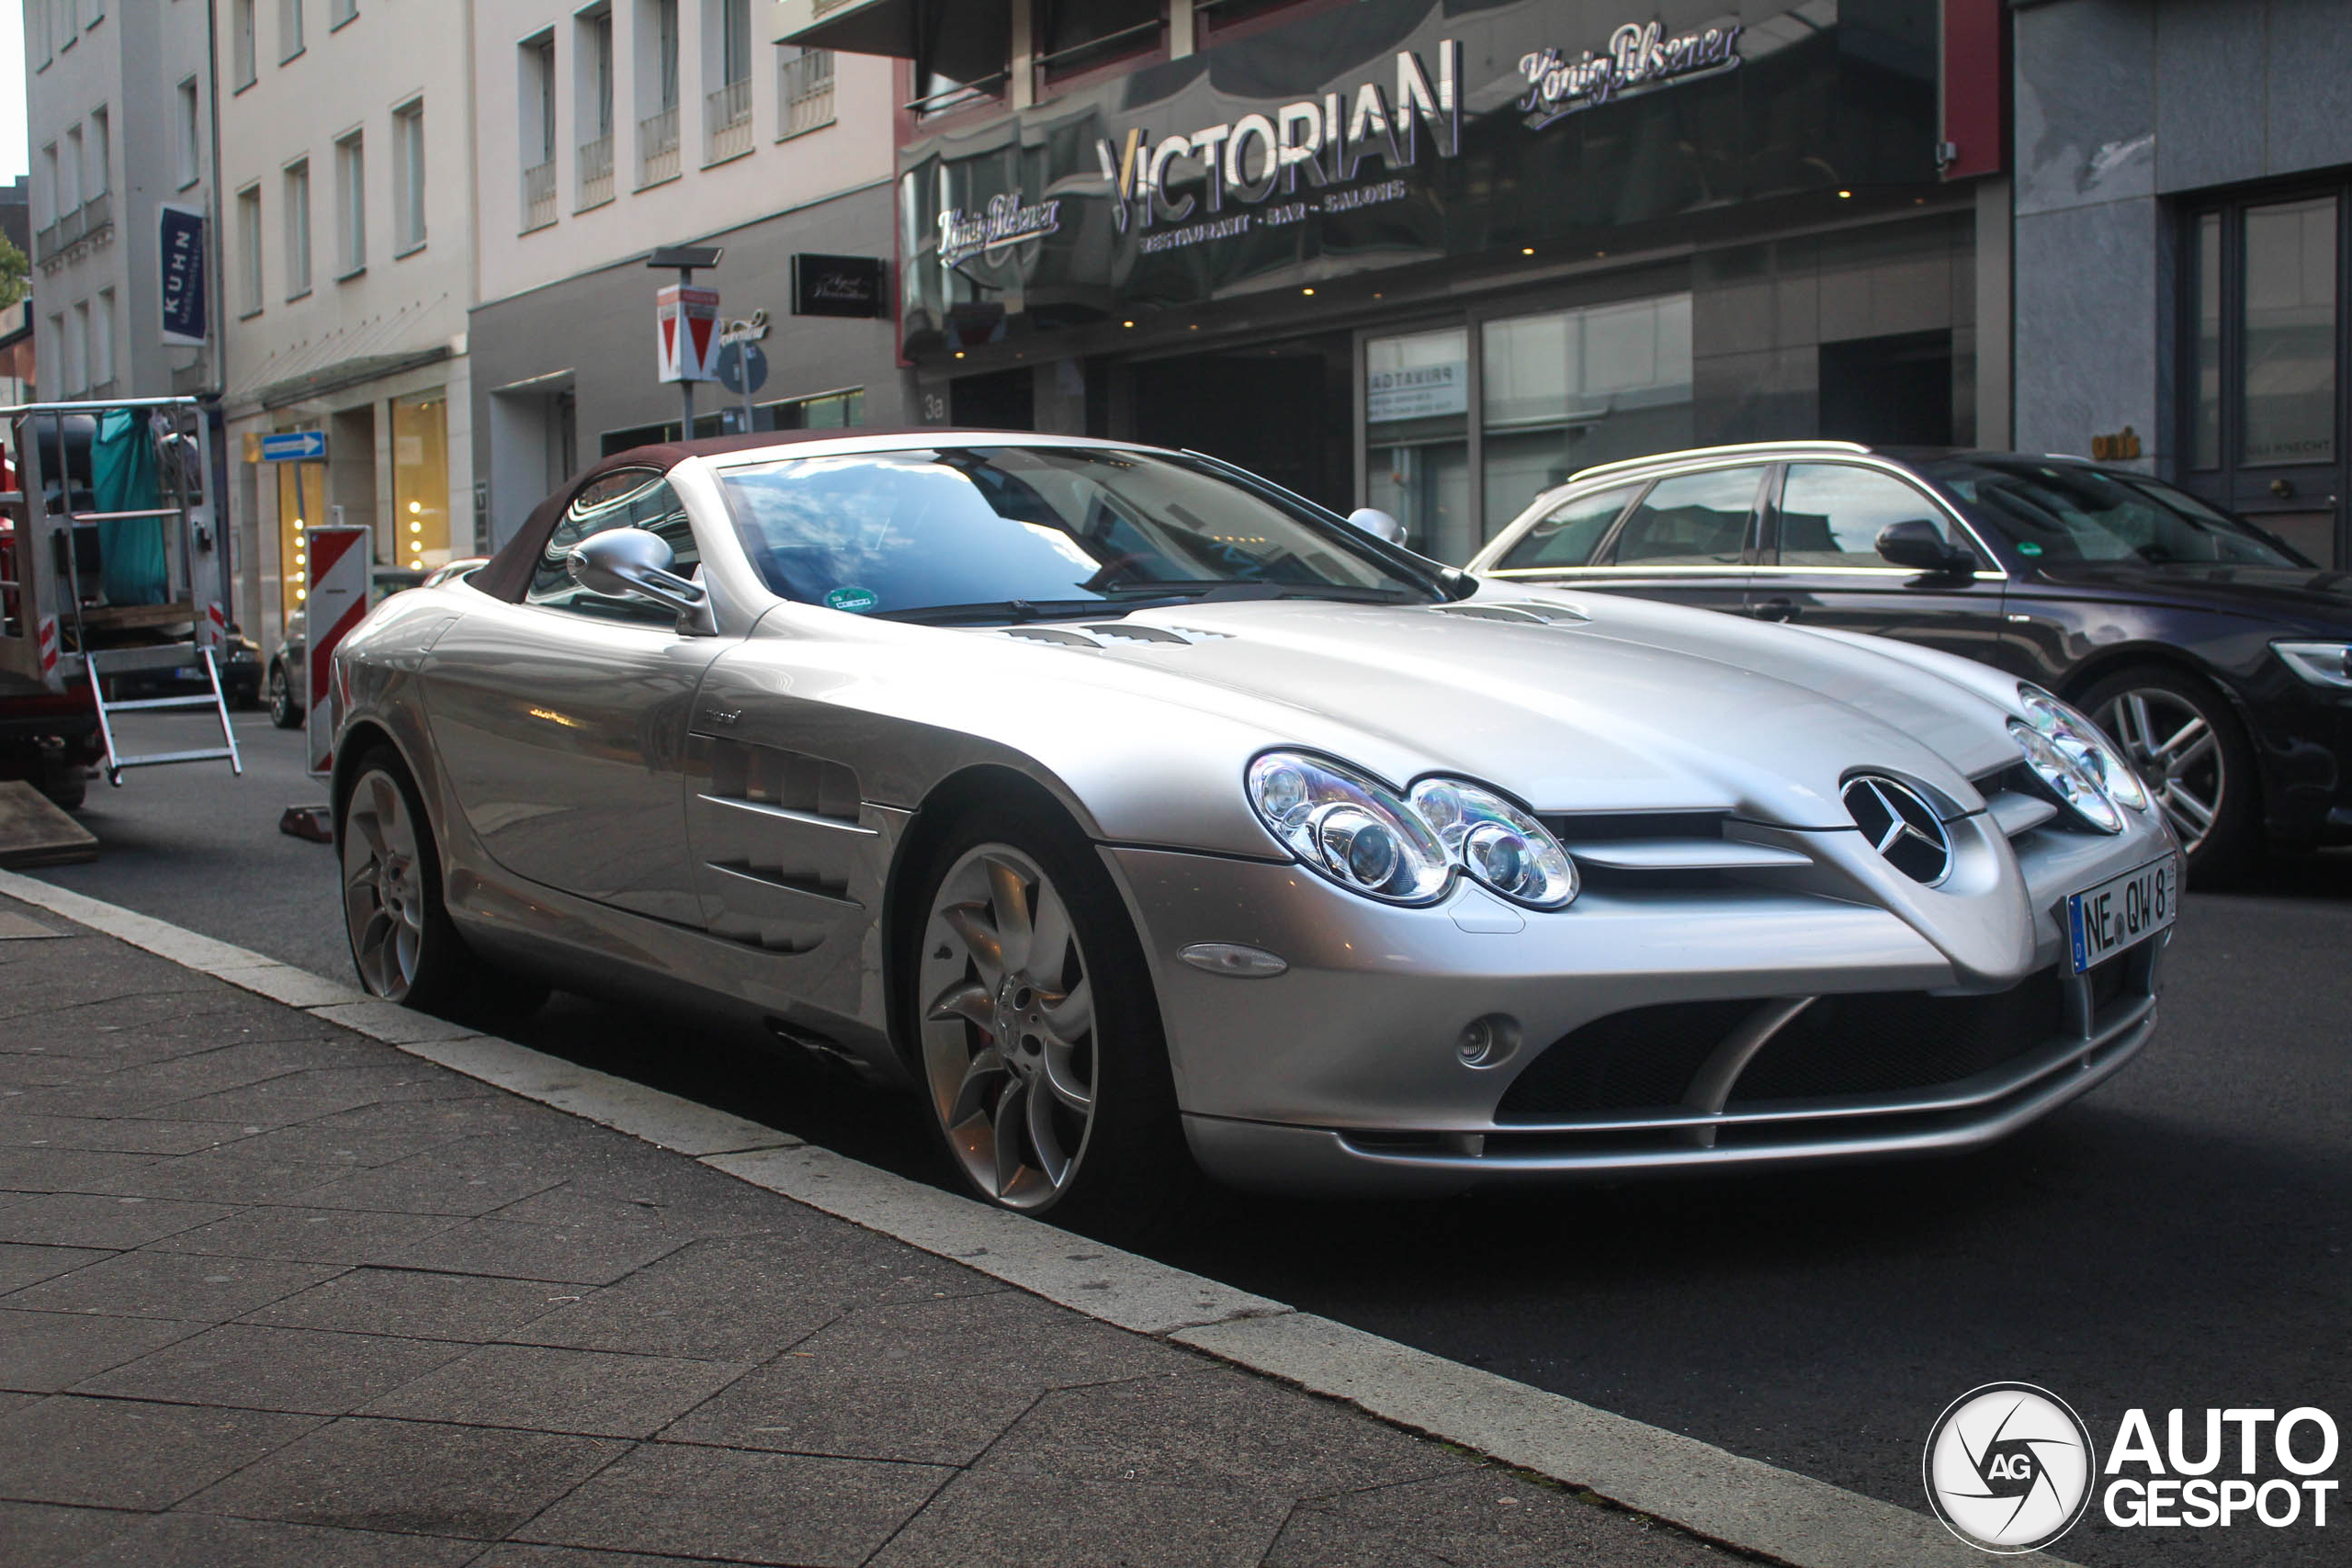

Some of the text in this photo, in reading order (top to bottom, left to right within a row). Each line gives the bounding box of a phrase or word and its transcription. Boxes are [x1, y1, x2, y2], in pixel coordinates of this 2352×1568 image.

[1519, 21, 1742, 113] König Pilsener
[1096, 39, 1464, 233] VICTORIAN
[937, 194, 1060, 255] König Pilsener
[1139, 179, 1406, 254] RESTAURANT BAR SALONS
[164, 231, 191, 313] KUHN
[924, 393, 944, 420] 3a
[2084, 891, 2114, 958] NE
[2126, 874, 2151, 935] QW
[2155, 868, 2165, 920] 8
